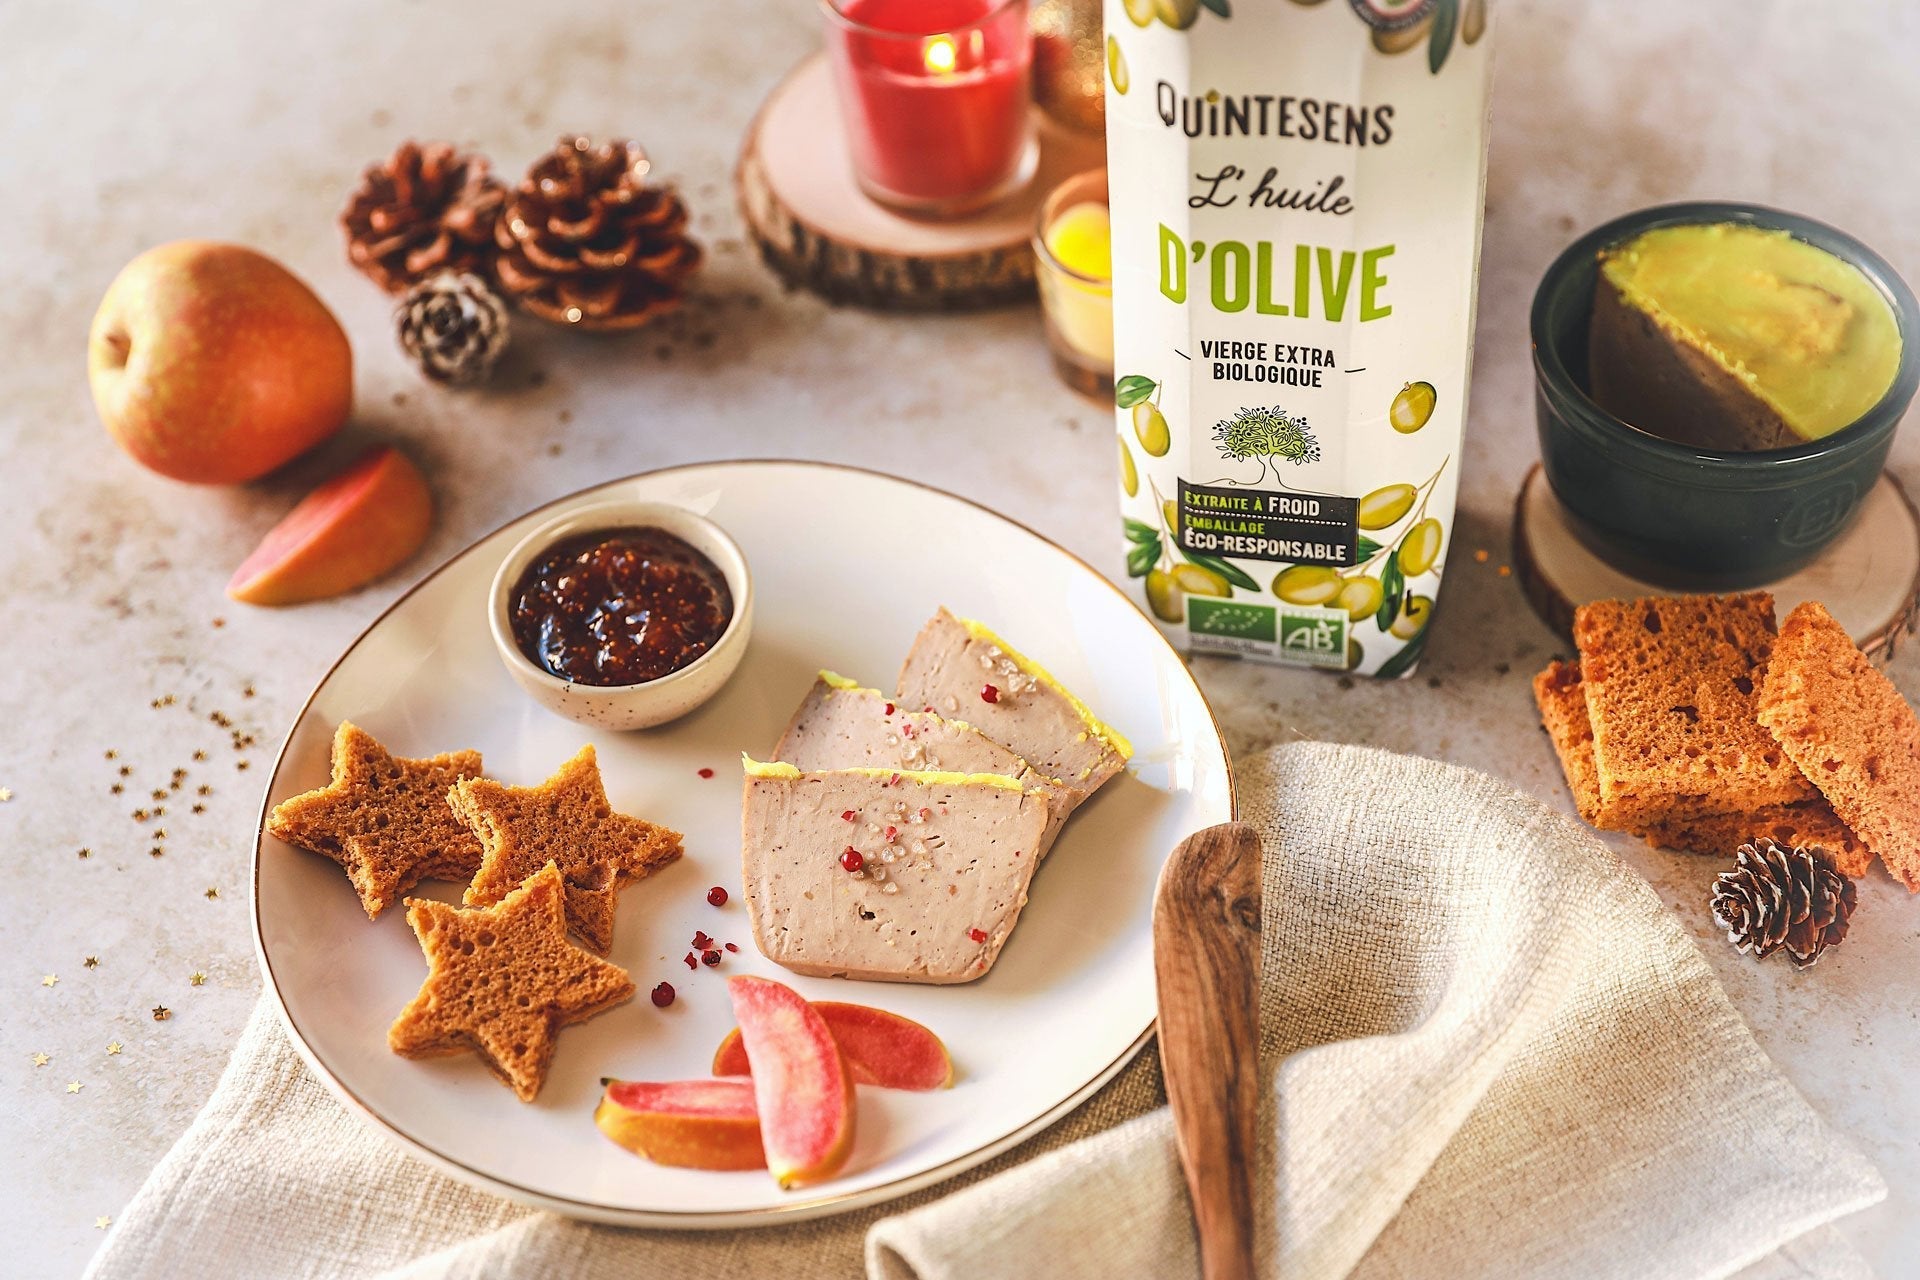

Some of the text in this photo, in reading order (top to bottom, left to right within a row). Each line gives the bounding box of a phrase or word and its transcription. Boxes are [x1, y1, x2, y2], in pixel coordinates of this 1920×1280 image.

[1157, 79, 1395, 147] QUINTESENS
[1158, 221, 1396, 323] D'OLIVE
[1200, 340, 1336, 368] VIERGE EXTRA
[1213, 362, 1323, 388] BIOLOGIQUE
[1184, 490, 1321, 517] EXTRAITE À FROID
[1184, 513, 1266, 535] EMBALLAGE
[1184, 526, 1347, 562] ÉCO-RESPONSABLE
[1284, 624, 1335, 651] AB
